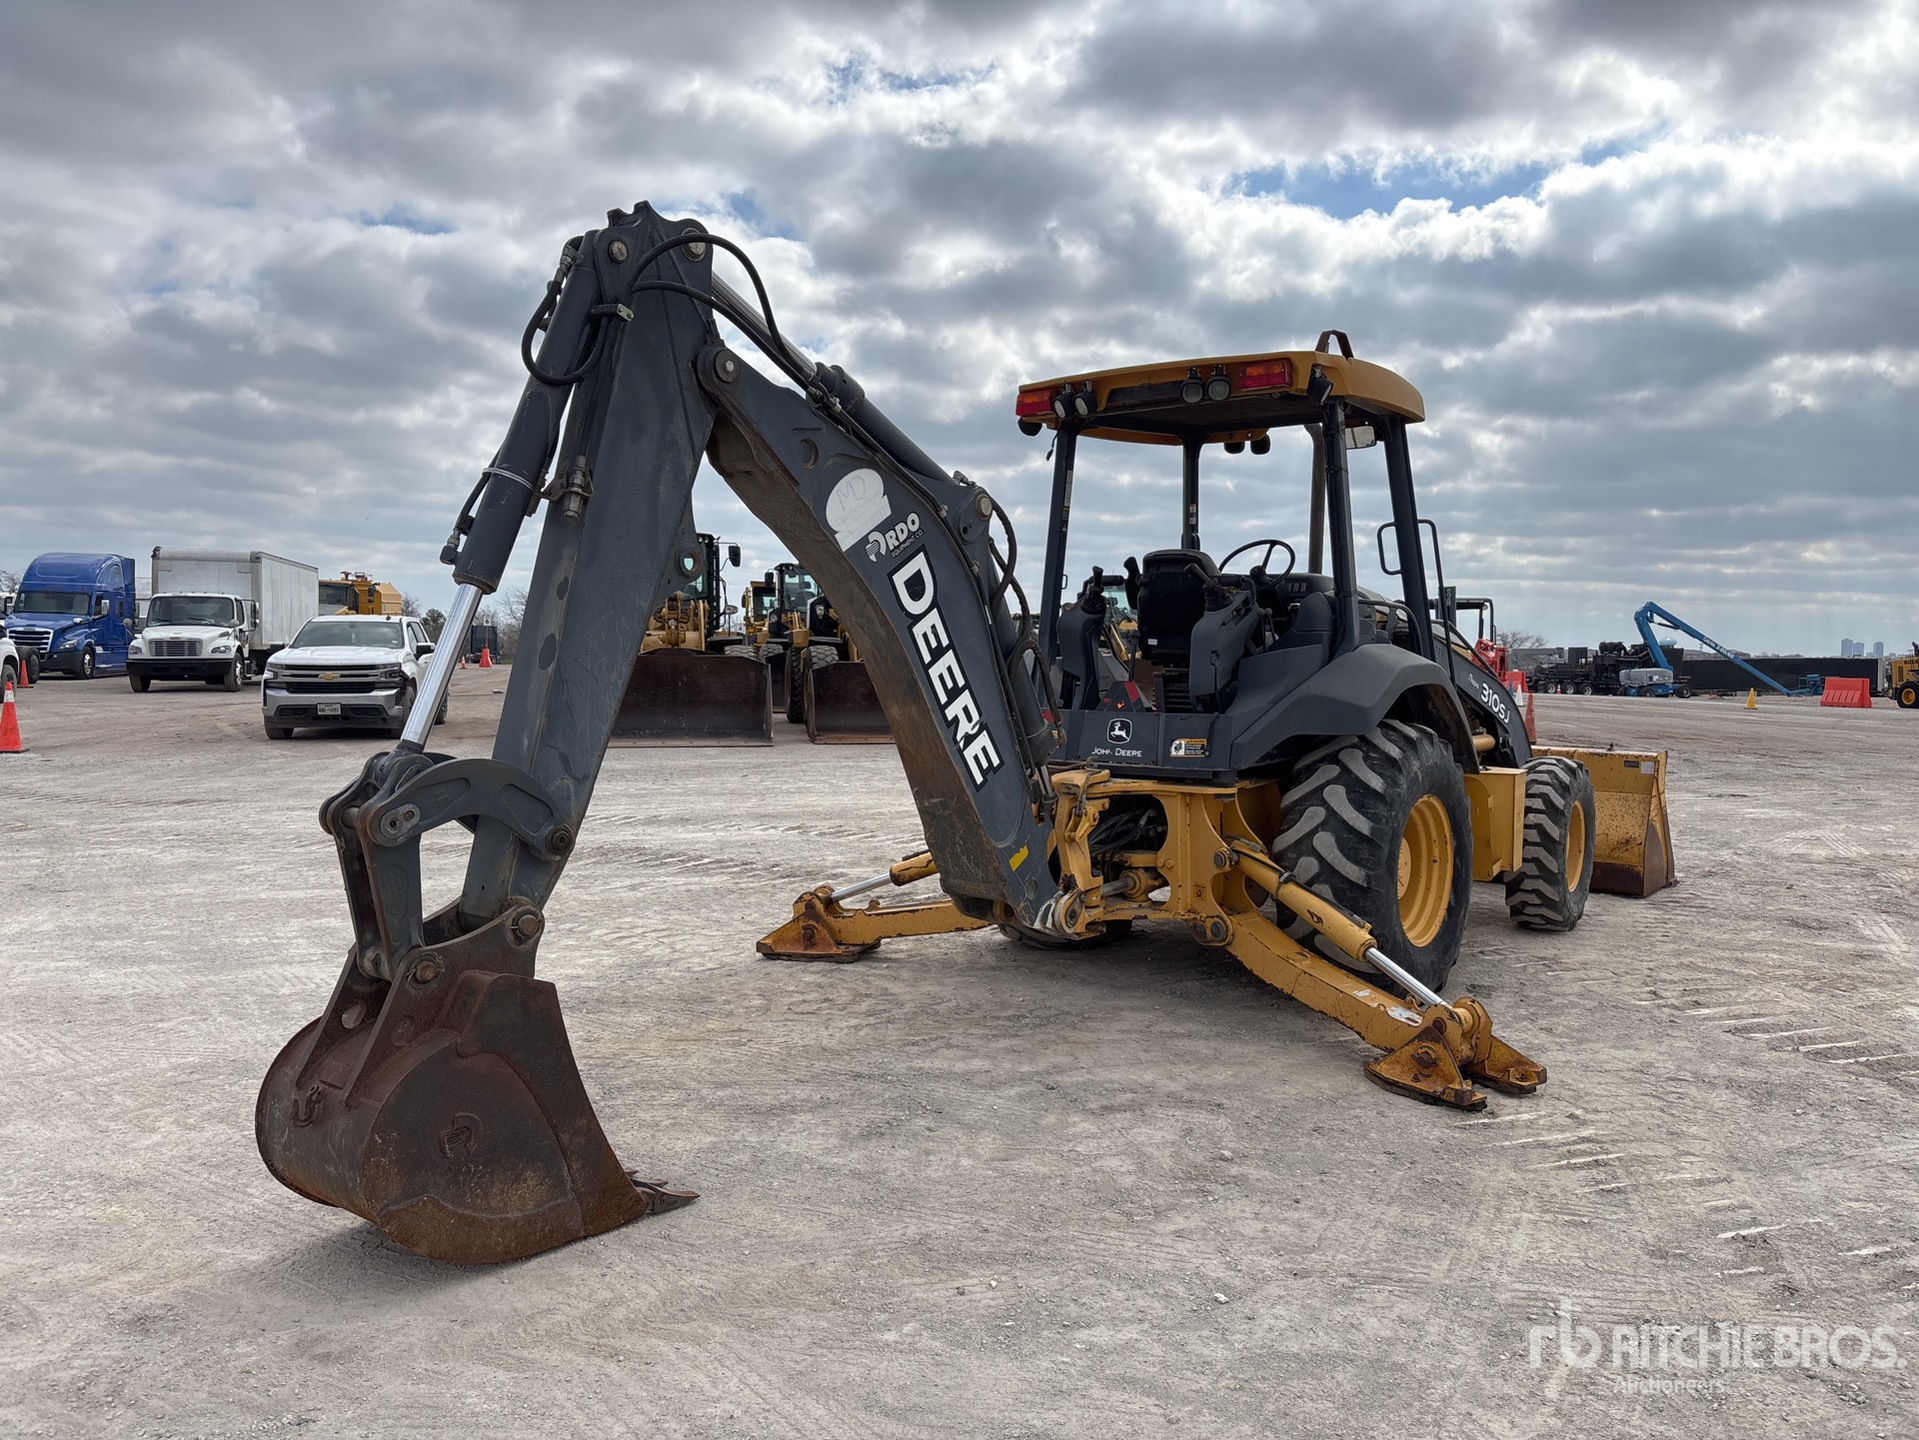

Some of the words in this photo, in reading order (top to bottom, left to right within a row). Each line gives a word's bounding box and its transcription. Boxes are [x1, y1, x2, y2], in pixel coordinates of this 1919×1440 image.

[884, 512, 920, 551] RDO
[892, 551, 1000, 786] DEERE
[1480, 682, 1511, 724] 310SJ
[1114, 747, 1143, 758] DEERE
